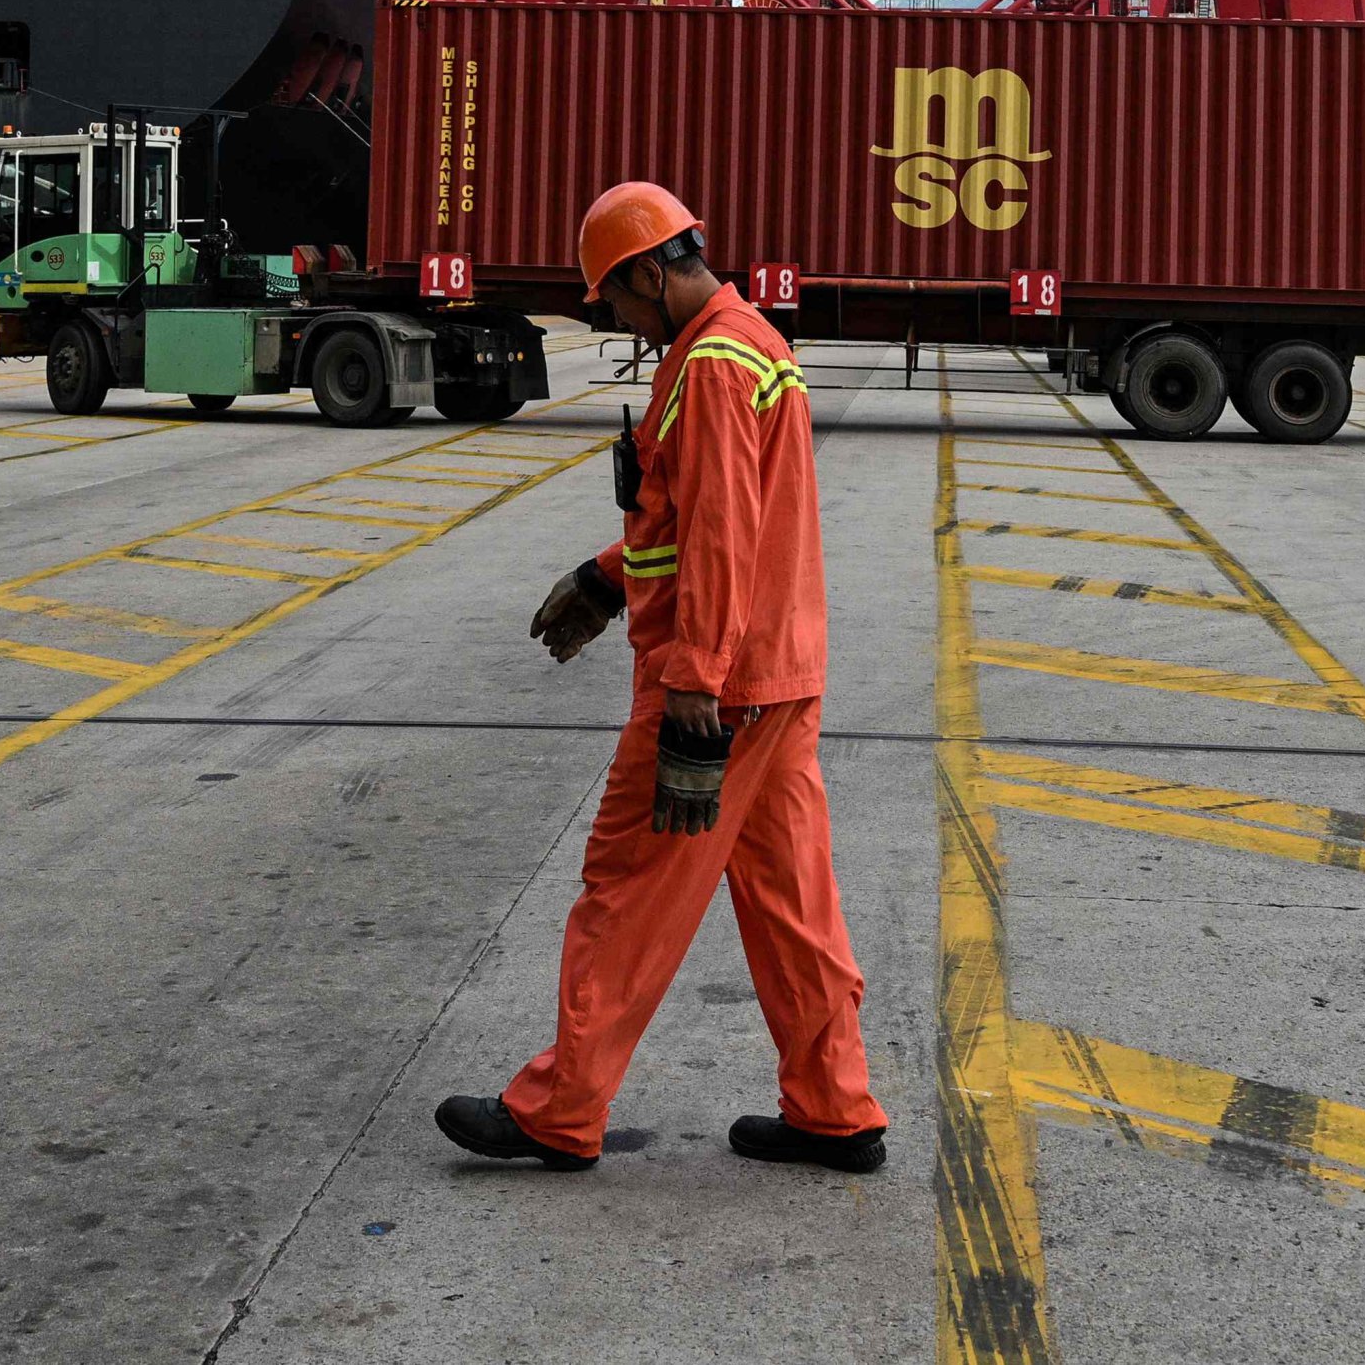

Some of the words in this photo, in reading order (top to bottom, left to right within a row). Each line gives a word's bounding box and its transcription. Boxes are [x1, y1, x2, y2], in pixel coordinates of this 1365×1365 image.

[463, 61, 478, 171] SHIPPING
[438, 47, 455, 226] MEDITERRANEAN
[461, 185, 474, 212] CO
[48, 253, 64, 264] 533
[150, 251, 164, 261] 533
